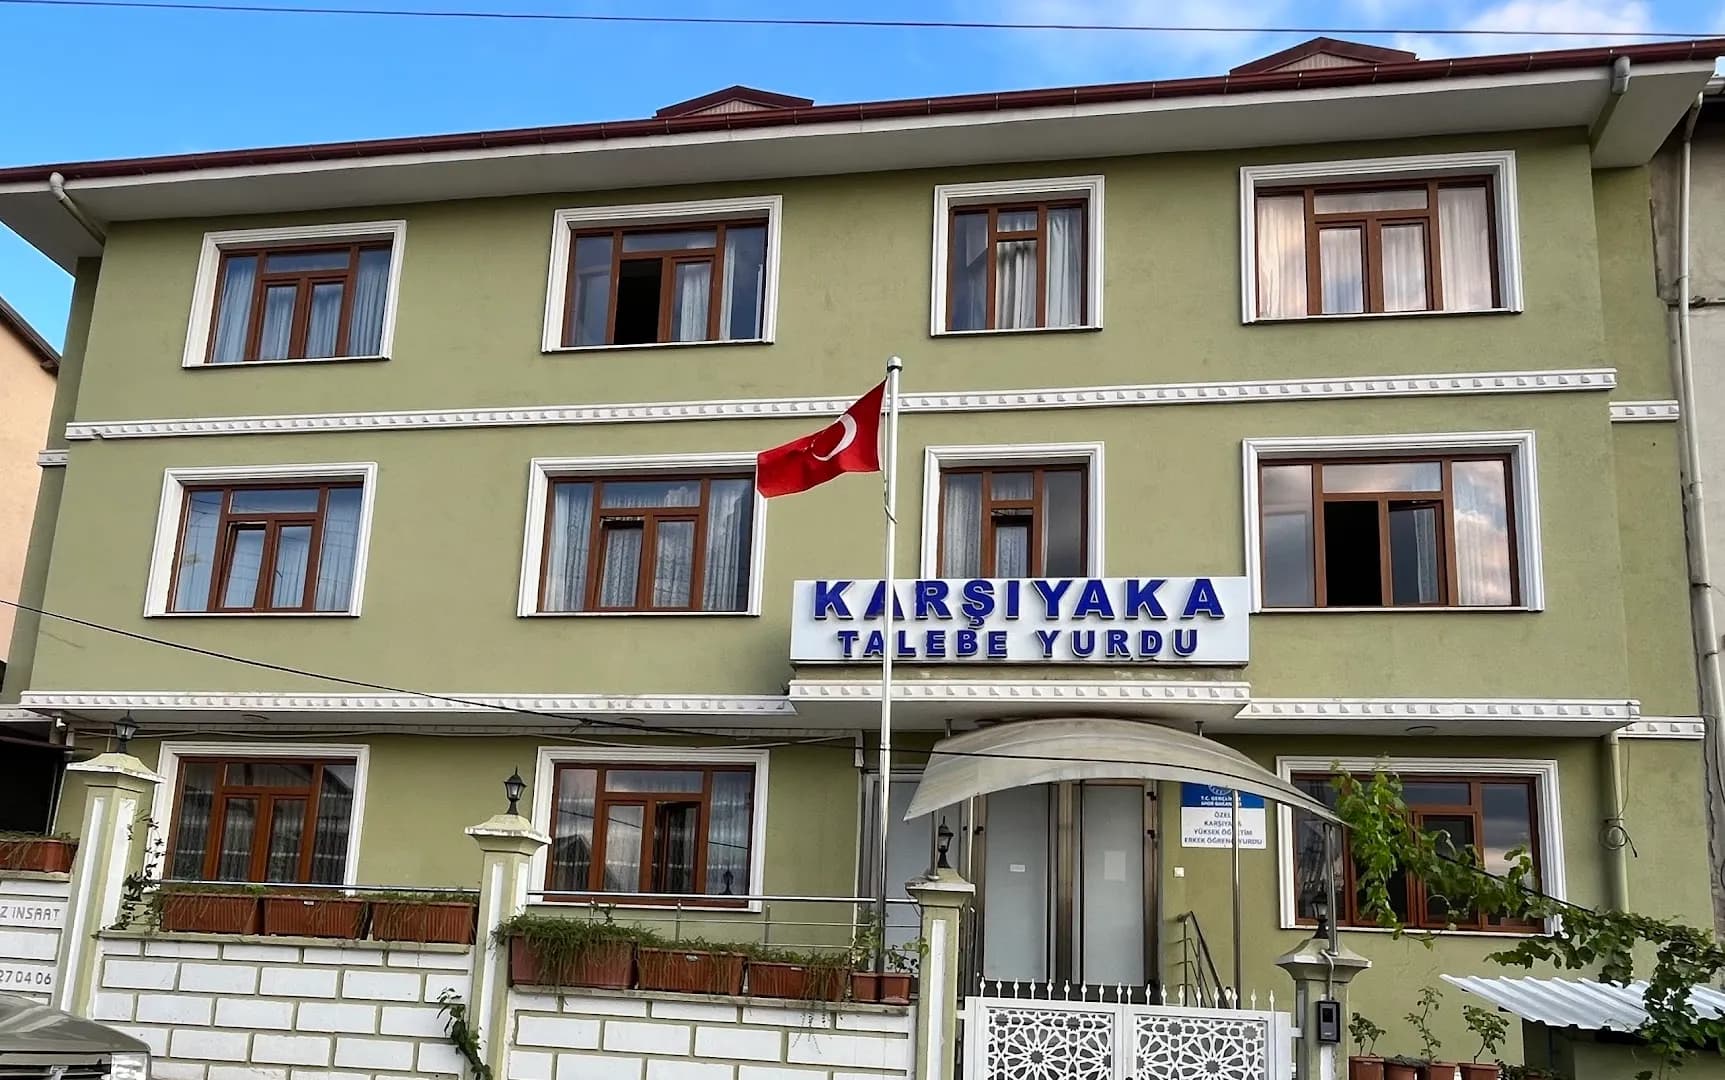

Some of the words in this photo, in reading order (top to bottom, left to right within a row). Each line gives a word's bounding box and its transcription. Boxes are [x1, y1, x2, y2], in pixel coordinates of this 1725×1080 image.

[814, 578, 1225, 629] KARŞIYAKA
[837, 629, 1008, 658] TALEBE
[1035, 629, 1198, 658] YURDU
[1221, 828, 1252, 836] ÖĞTİM
